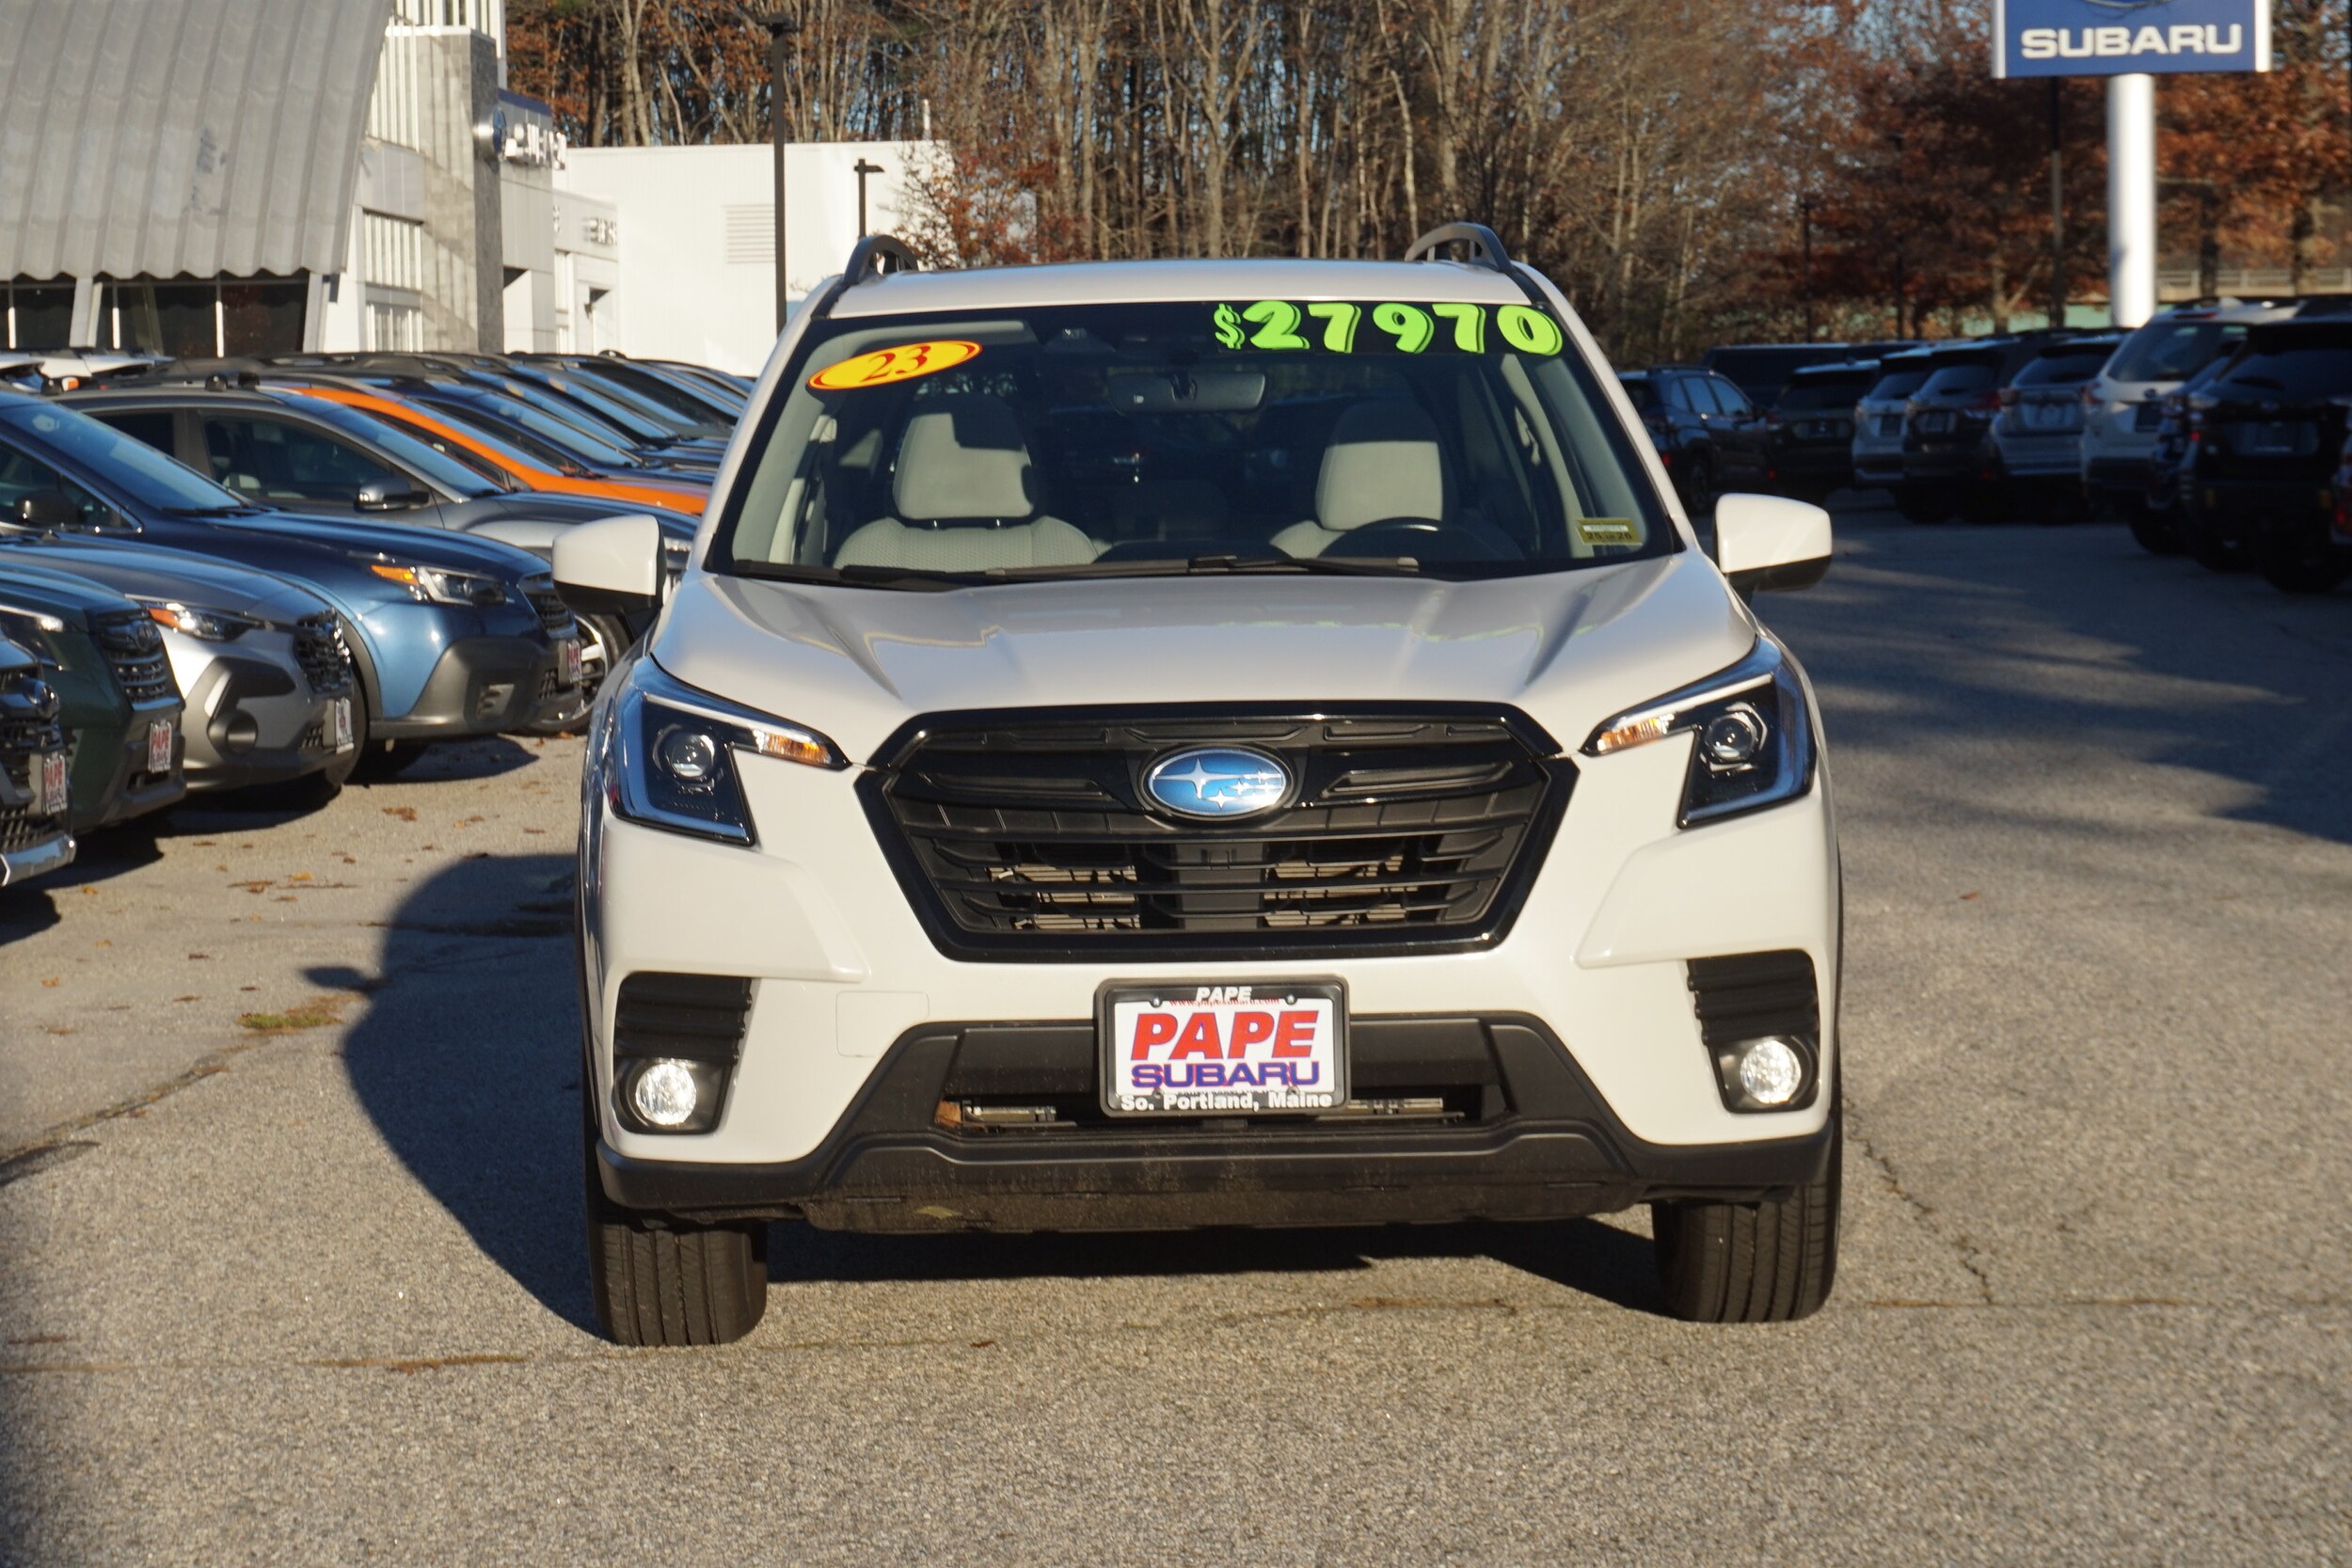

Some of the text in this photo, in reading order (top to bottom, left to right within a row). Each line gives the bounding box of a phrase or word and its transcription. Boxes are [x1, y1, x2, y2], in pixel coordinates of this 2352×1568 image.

[2021, 24, 2242, 58] SUBARU
[1213, 299, 1563, 356] $27970
[860, 345, 931, 383] 23
[1195, 986, 1252, 1003] PAPE
[1131, 1010, 1319, 1060] PAPE
[1131, 1060, 1320, 1088] SUBARU
[1120, 1089, 1332, 1112] So. Portland, Maine
